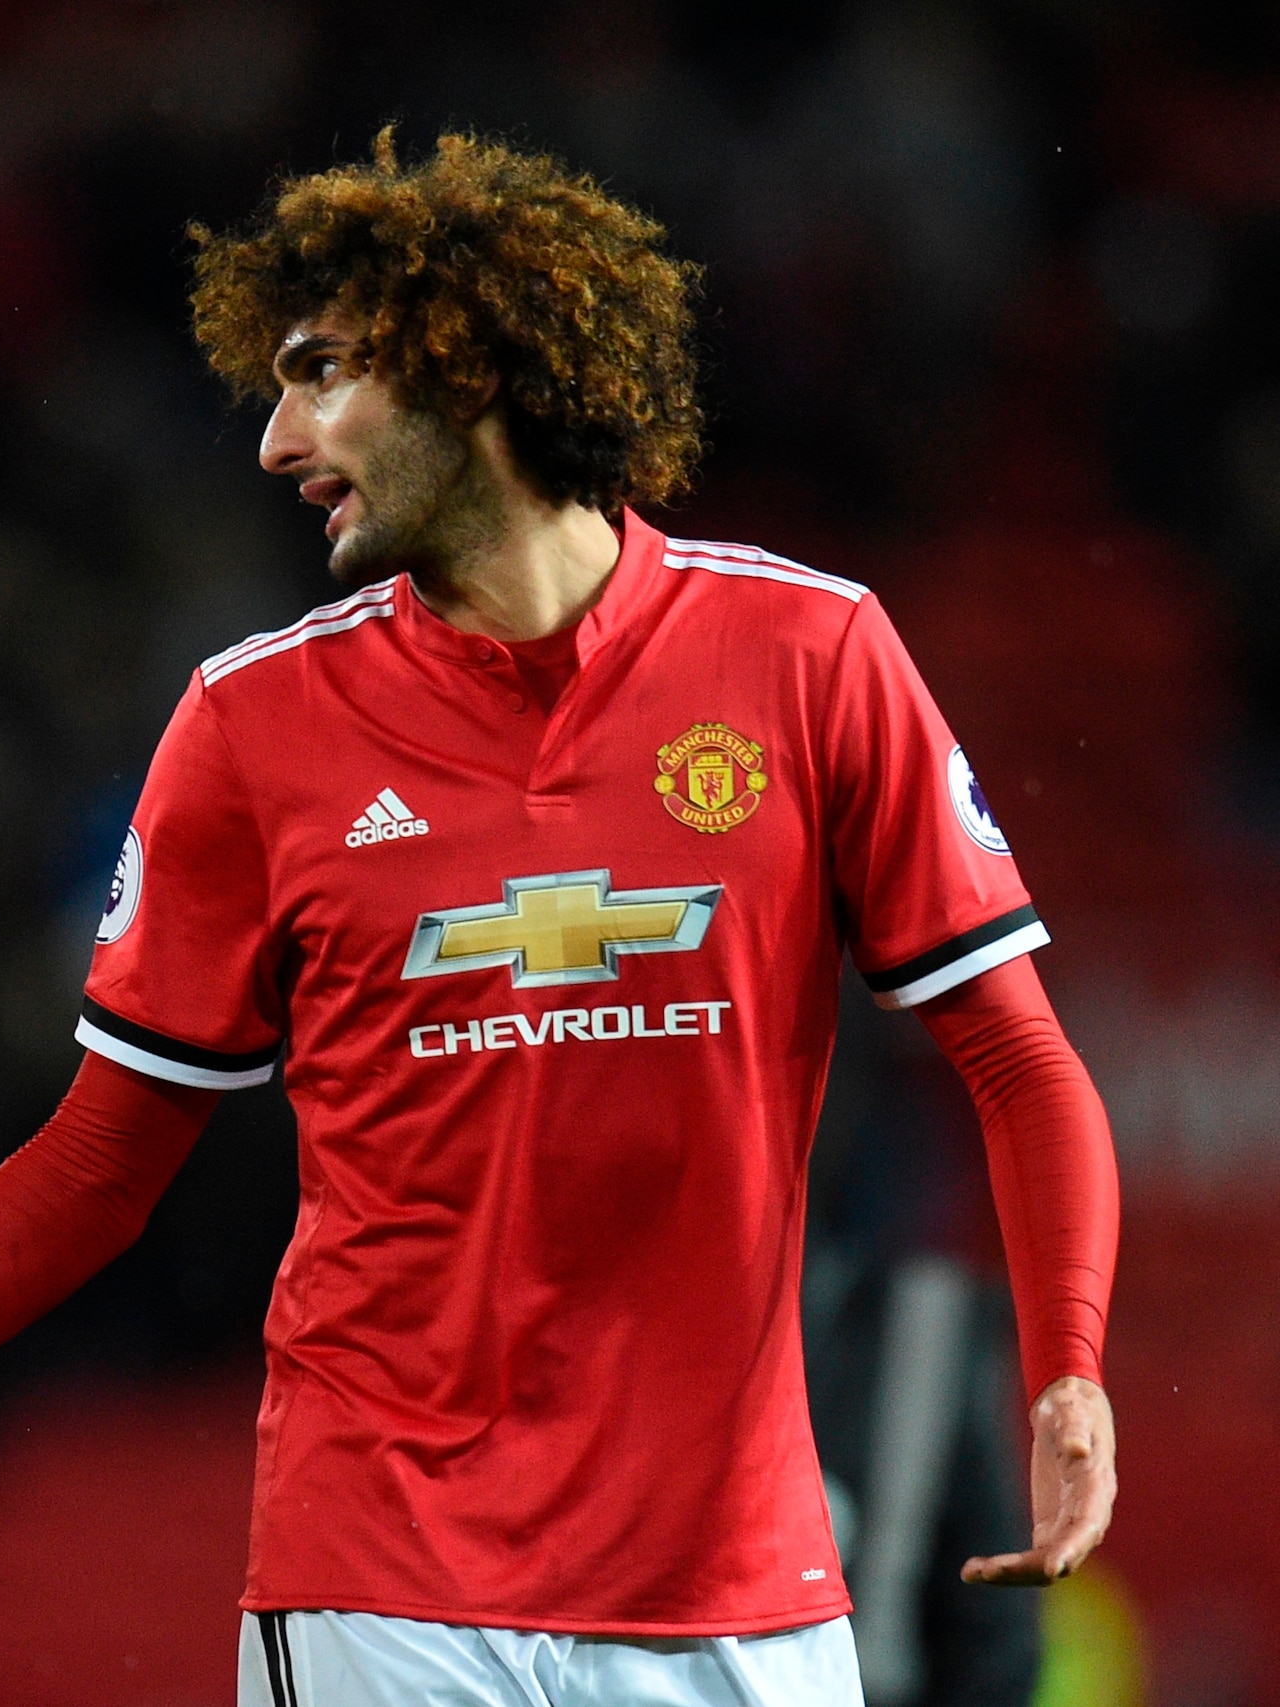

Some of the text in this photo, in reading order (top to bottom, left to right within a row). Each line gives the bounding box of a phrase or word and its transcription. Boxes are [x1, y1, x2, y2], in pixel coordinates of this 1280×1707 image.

[665, 731, 754, 767] MANCHESTER
[681, 806, 744, 826] UNITED
[345, 819, 429, 848] adidas
[409, 1001, 732, 1058] CHEVROLET
